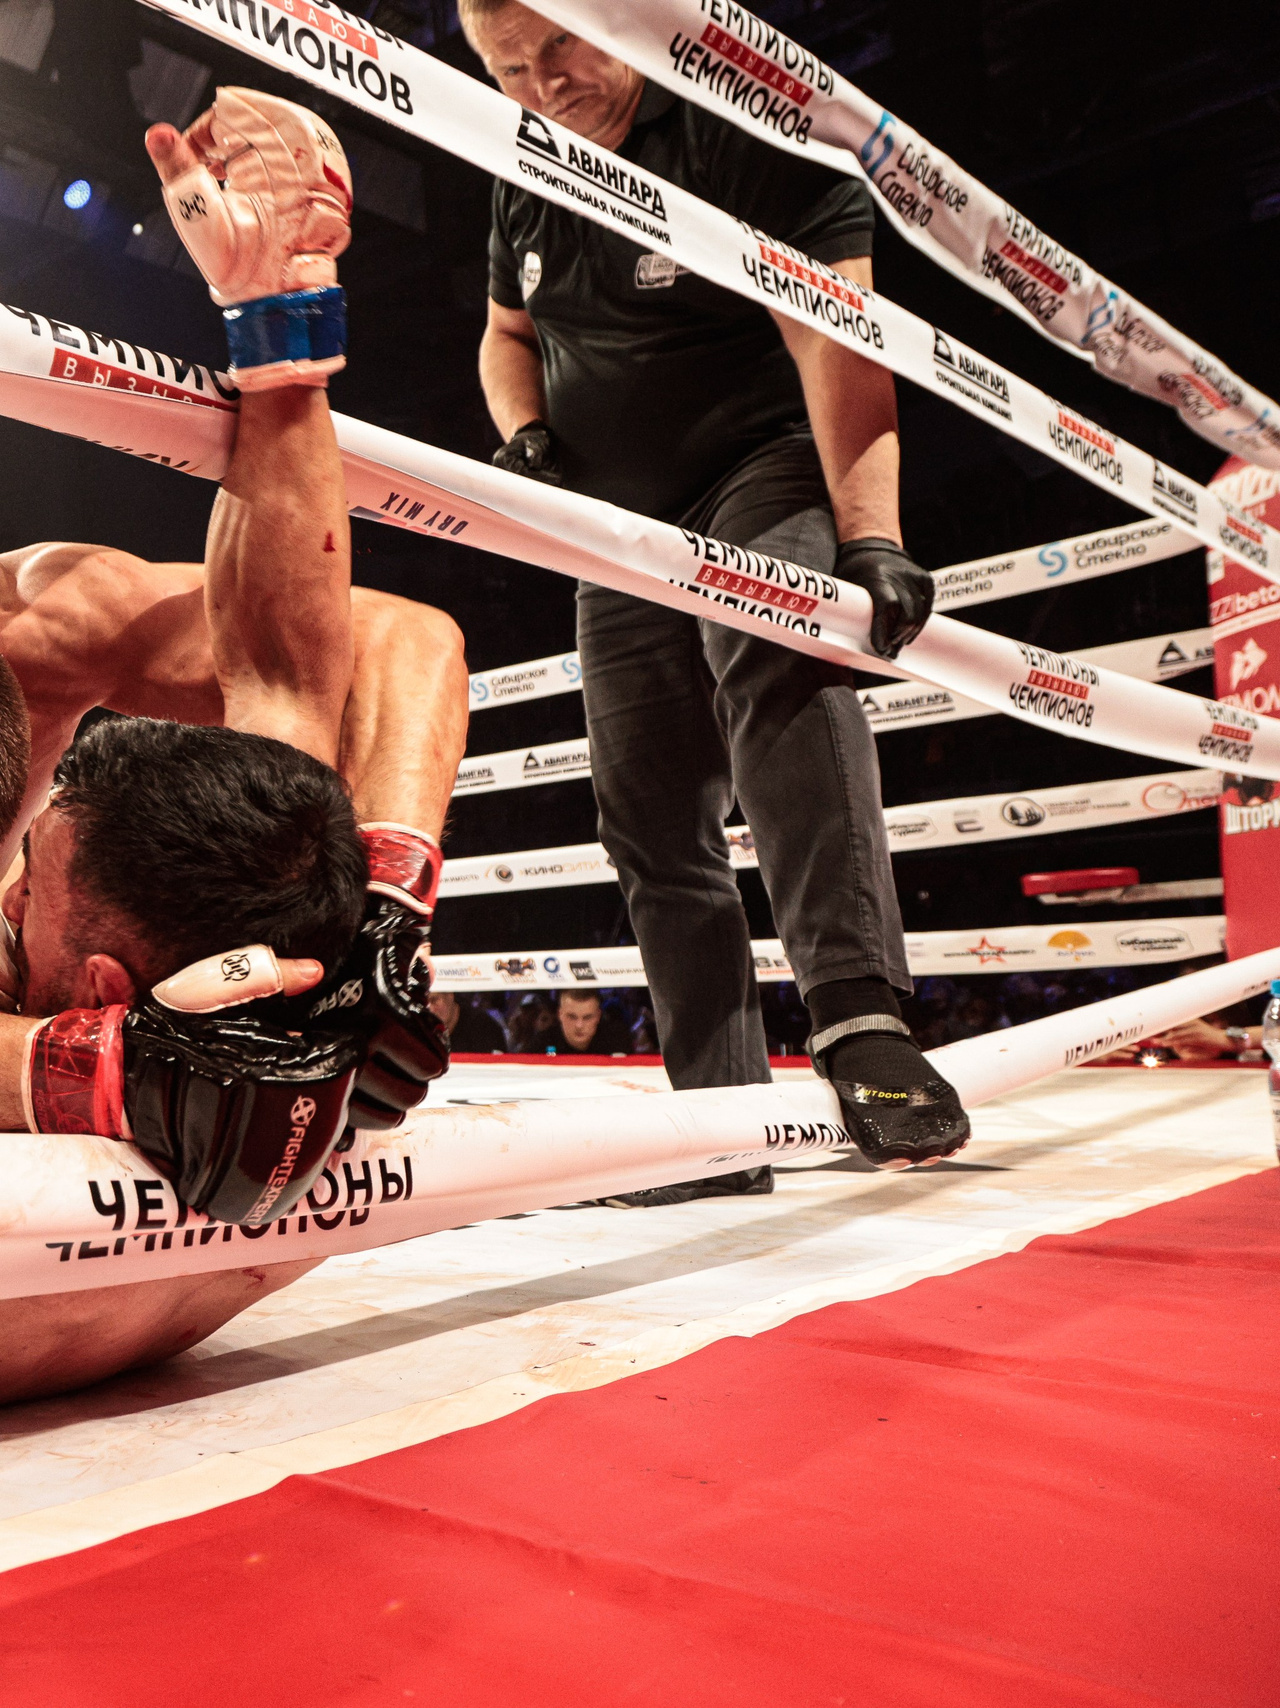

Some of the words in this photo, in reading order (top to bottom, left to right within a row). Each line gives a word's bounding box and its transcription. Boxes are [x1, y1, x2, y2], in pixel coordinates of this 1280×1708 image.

[669, 32, 814, 145] ЧЕМПИОНОВ
[707, 28, 808, 101] ВЫЗЫВАЮТ
[518, 159, 610, 215] СТРОИТЕЛЬНАЯ
[610, 204, 673, 246] КОМПАНИЯ
[568, 142, 668, 222] АВАНГАРД
[897, 142, 969, 213] Сибирское
[742, 252, 885, 350] ЧЕМПИОНОВ
[765, 247, 862, 308] ВЫЗЫВАЮТ
[1048, 420, 1123, 485] ЧЕМПИОНОВ
[380, 491, 425, 521] MIX
[423, 510, 469, 536] DRY
[681, 526, 839, 602] ЧЕМПИОНЫ
[702, 568, 813, 613] ВЫЗЫВАЮТ
[1009, 682, 1095, 728] ЧЕМПИОНОВ
[863, 1089, 908, 1099] UTDOOR
[245, 1126, 308, 1223] FIGHTEXPERT
